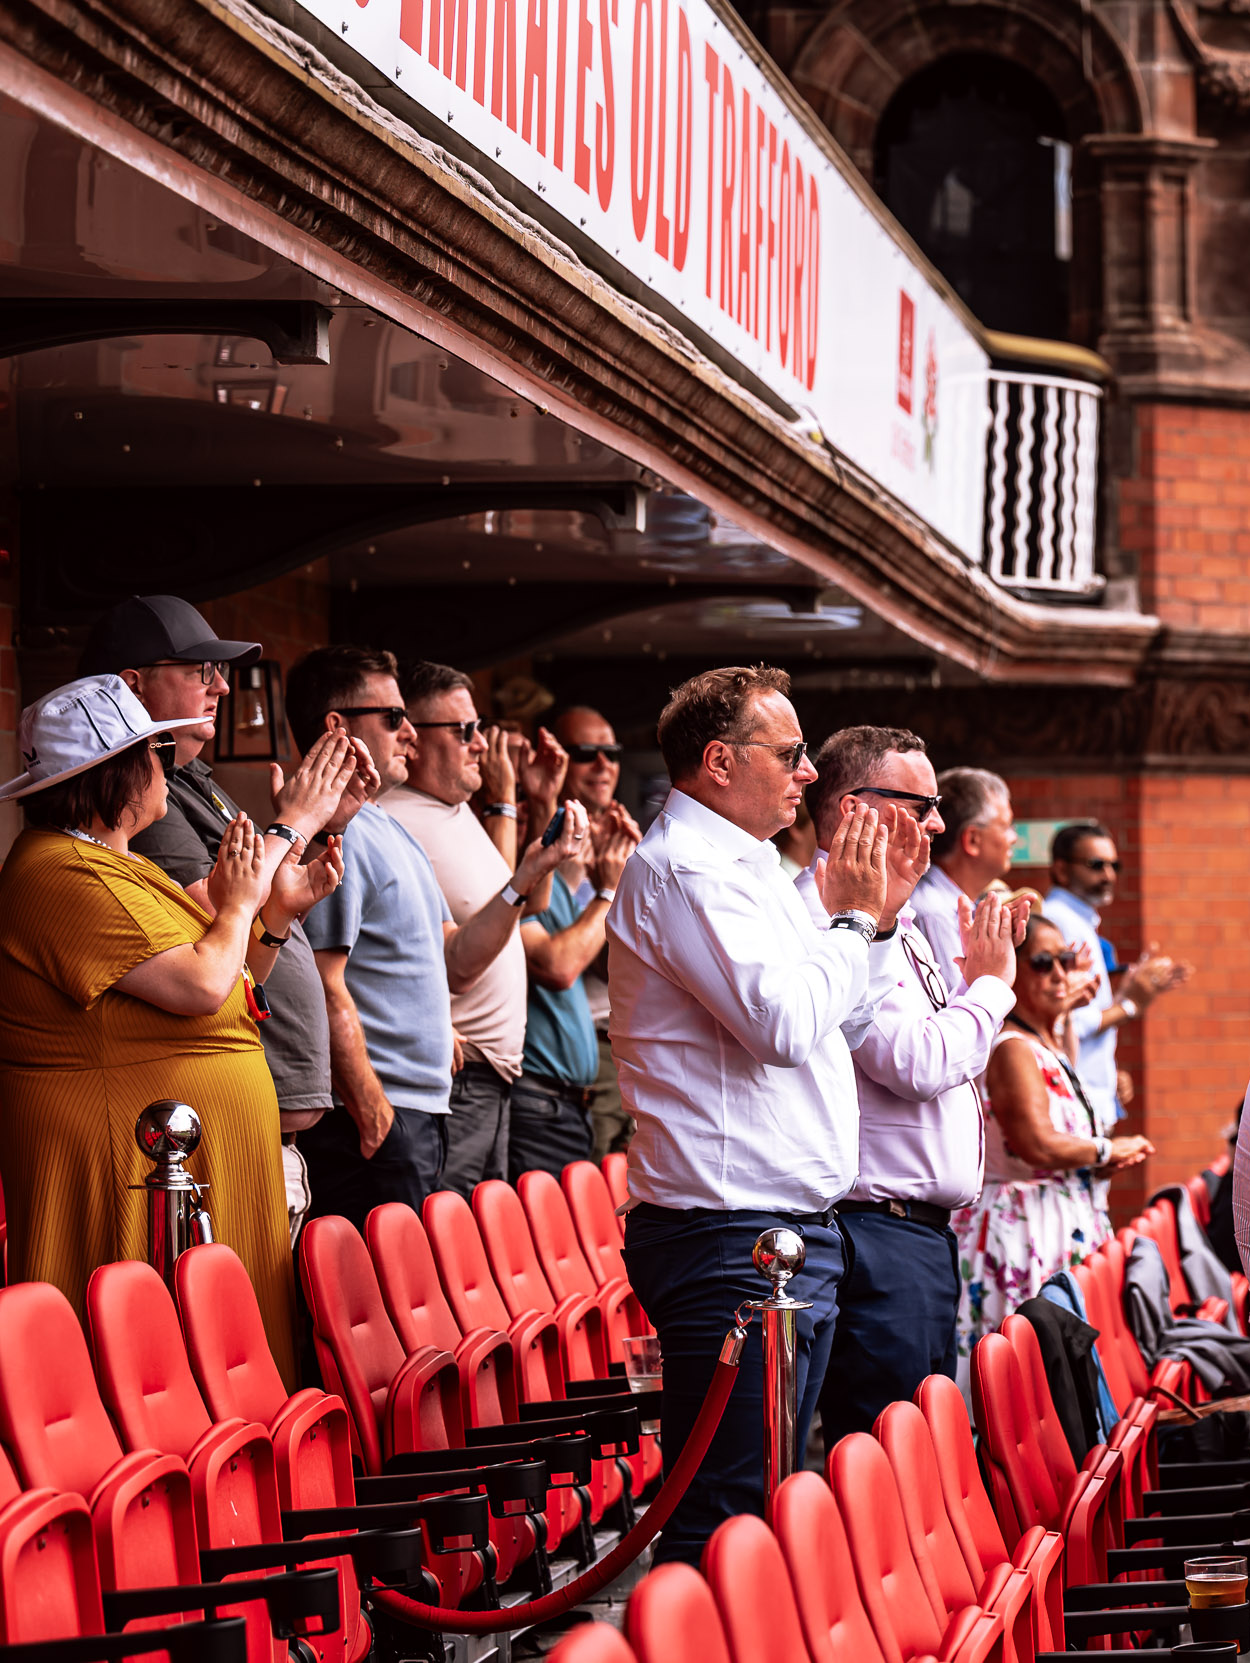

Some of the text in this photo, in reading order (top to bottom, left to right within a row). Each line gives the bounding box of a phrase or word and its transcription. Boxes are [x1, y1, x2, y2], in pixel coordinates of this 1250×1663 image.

[399, 0, 618, 213] ATES
[630, 0, 693, 273] OLD
[705, 40, 820, 392] TRAFFORD
